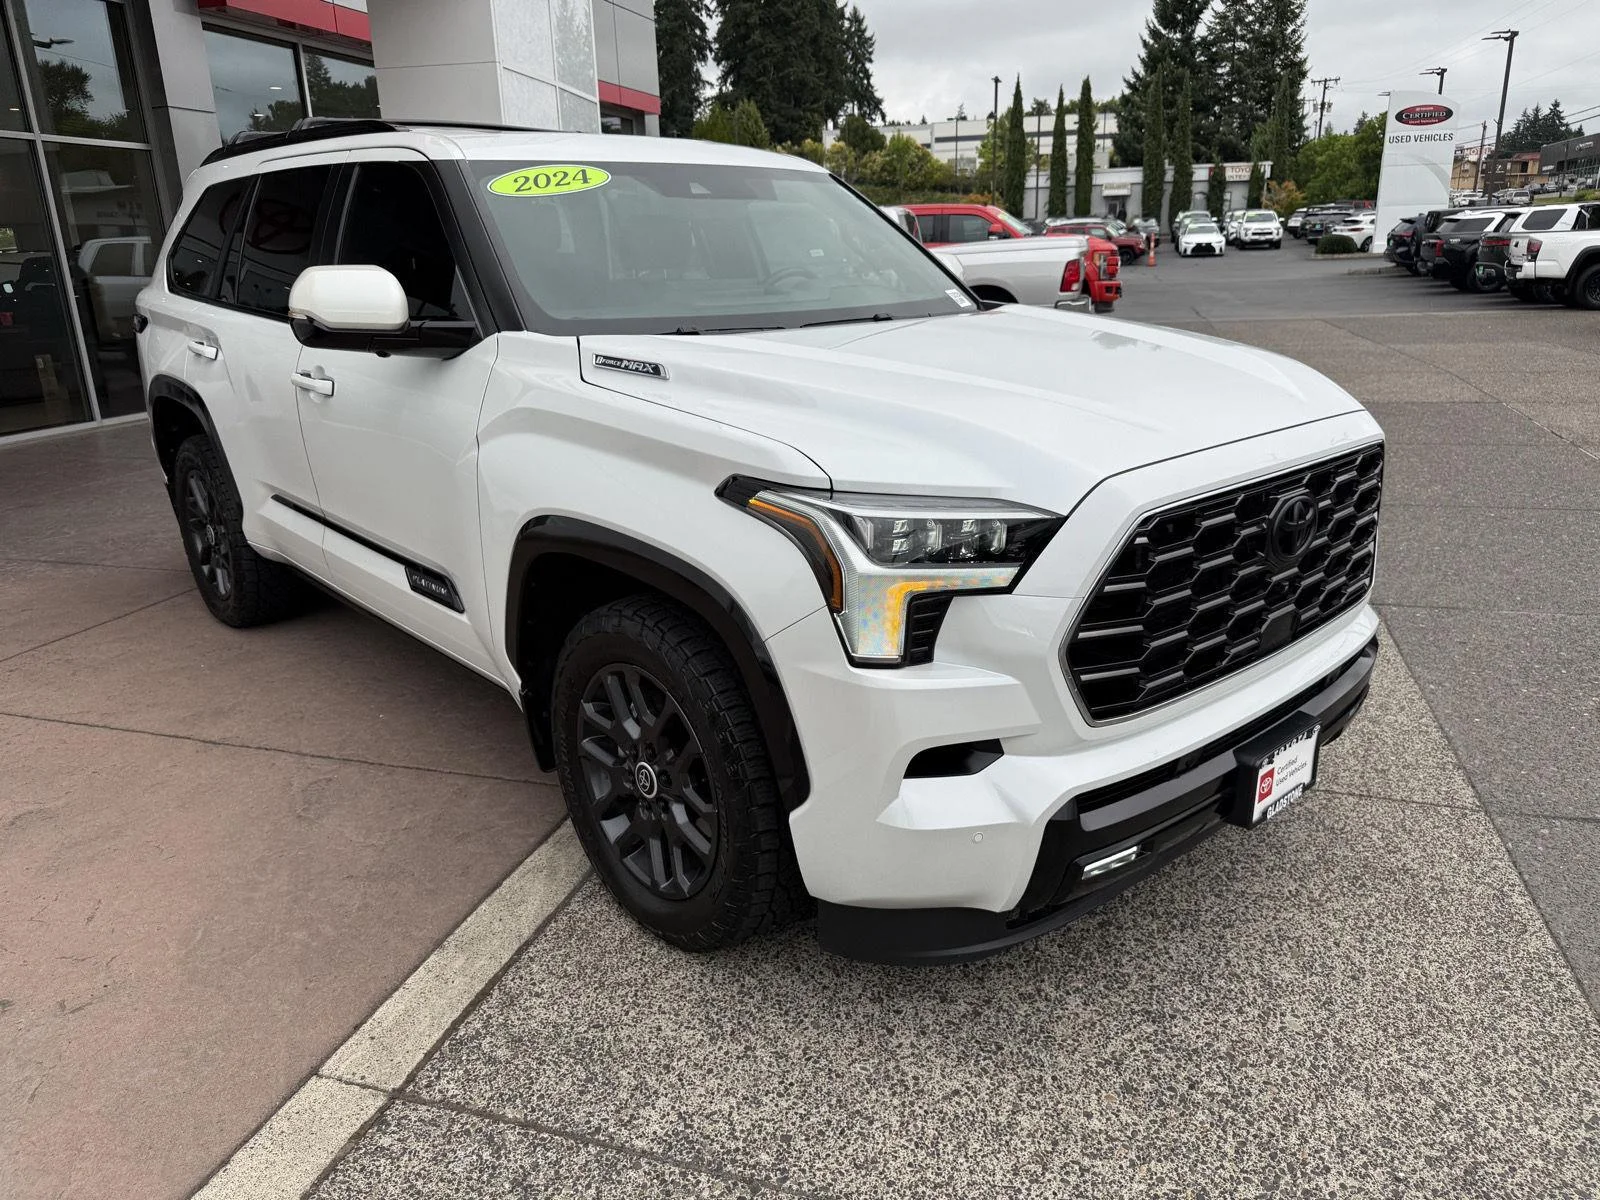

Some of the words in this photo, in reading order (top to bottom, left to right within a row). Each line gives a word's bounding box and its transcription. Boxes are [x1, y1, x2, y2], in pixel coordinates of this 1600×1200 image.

[1388, 135, 1412, 144] USED
[1413, 132, 1454, 143] VEHICLES
[513, 168, 592, 192] 2024
[620, 360, 656, 373] MAX
[1275, 772, 1289, 786] Used
[1288, 760, 1308, 777] Vehicles
[1277, 756, 1298, 775] Certified
[1266, 783, 1304, 820] GLADSTONE
